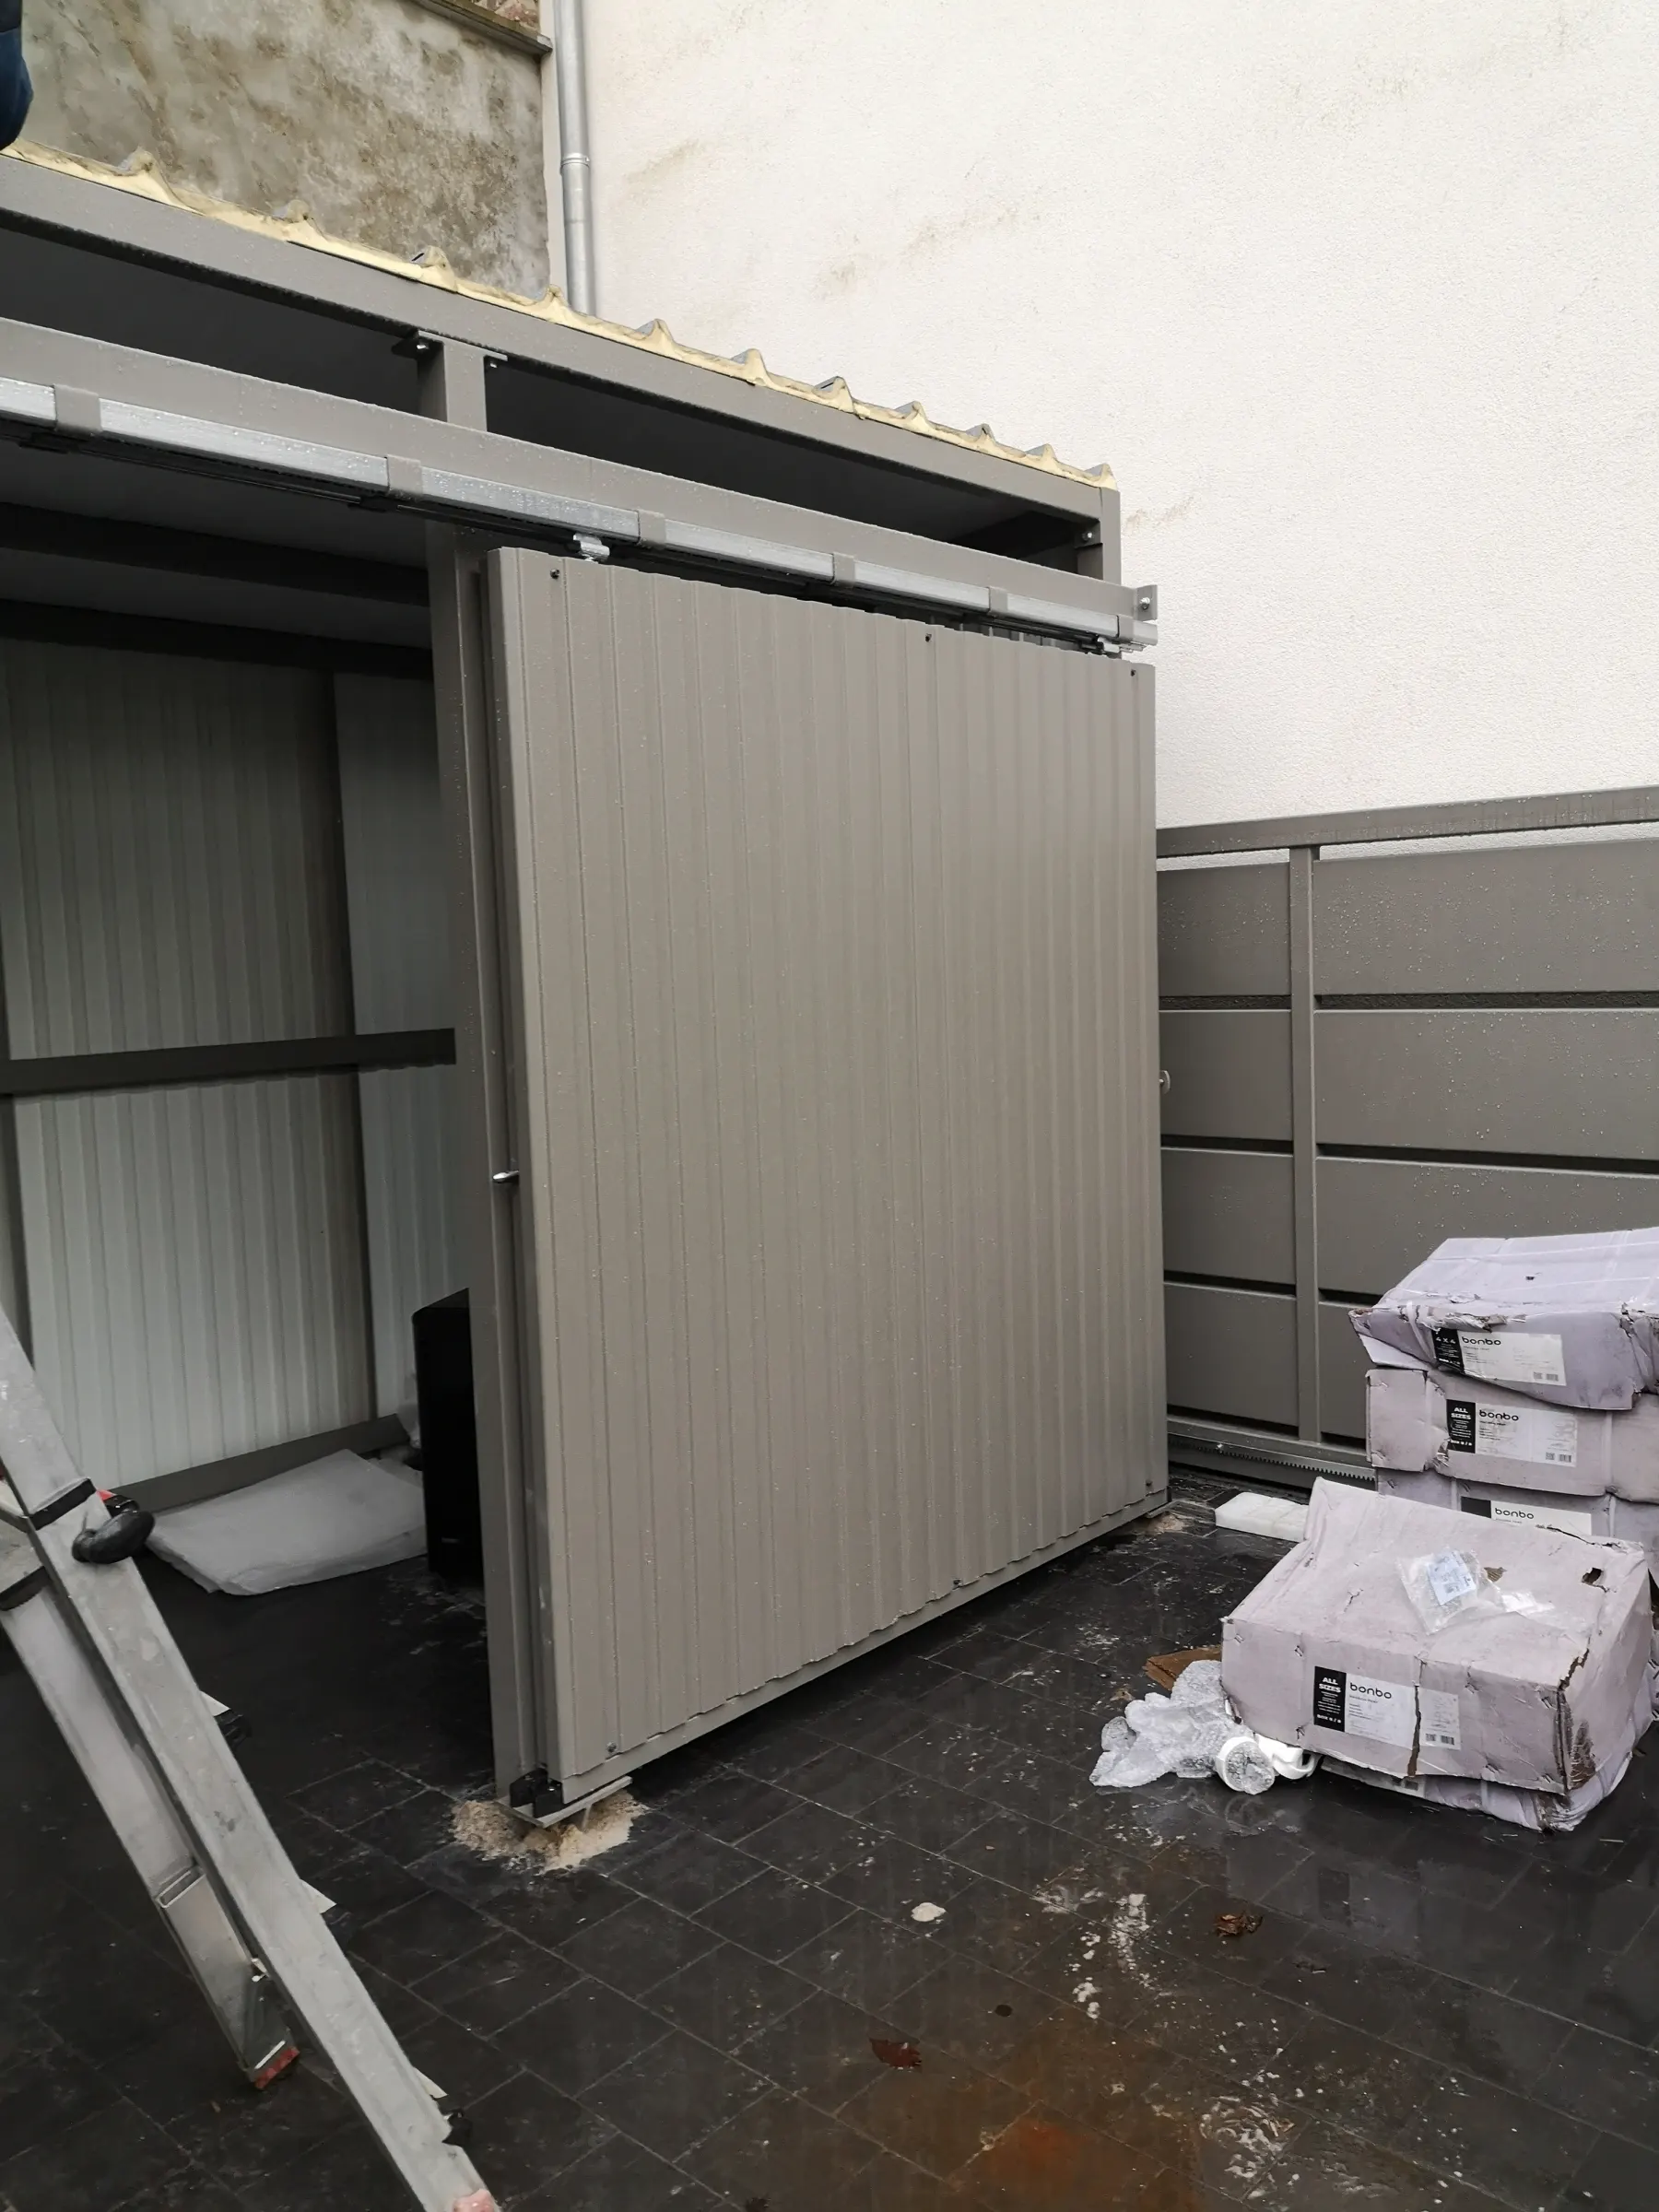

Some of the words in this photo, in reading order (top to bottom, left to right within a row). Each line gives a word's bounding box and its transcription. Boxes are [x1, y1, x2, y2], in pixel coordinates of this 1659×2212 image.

[1462, 1336, 1501, 1346] bonbo
[1478, 1409, 1520, 1421] bonbo
[1494, 1507, 1535, 1520] bonbo
[1322, 1677, 1339, 1686] ALL
[1318, 1683, 1342, 1693] SIZES
[1349, 1682, 1392, 1699] bonbo
